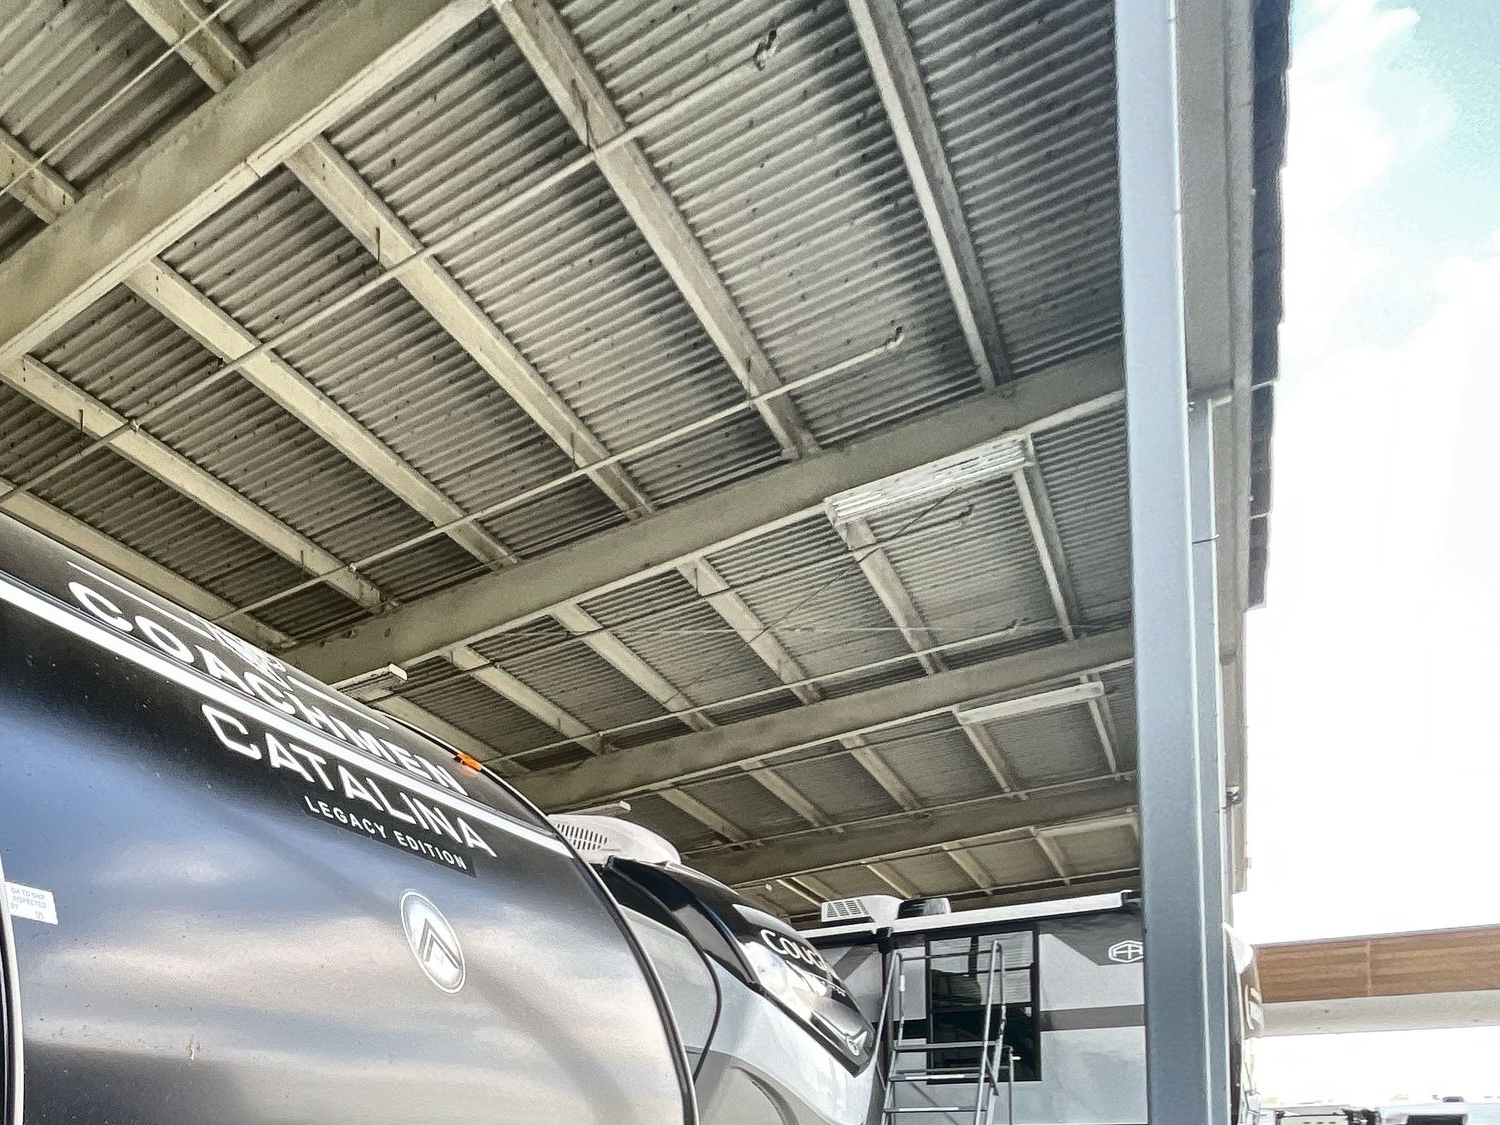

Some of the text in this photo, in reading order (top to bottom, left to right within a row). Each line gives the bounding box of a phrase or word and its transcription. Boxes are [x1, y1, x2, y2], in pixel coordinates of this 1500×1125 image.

[68, 581, 468, 796] COACHMEN
[201, 704, 498, 857] CATALINA
[304, 795, 467, 870] LEGACY EDITION
